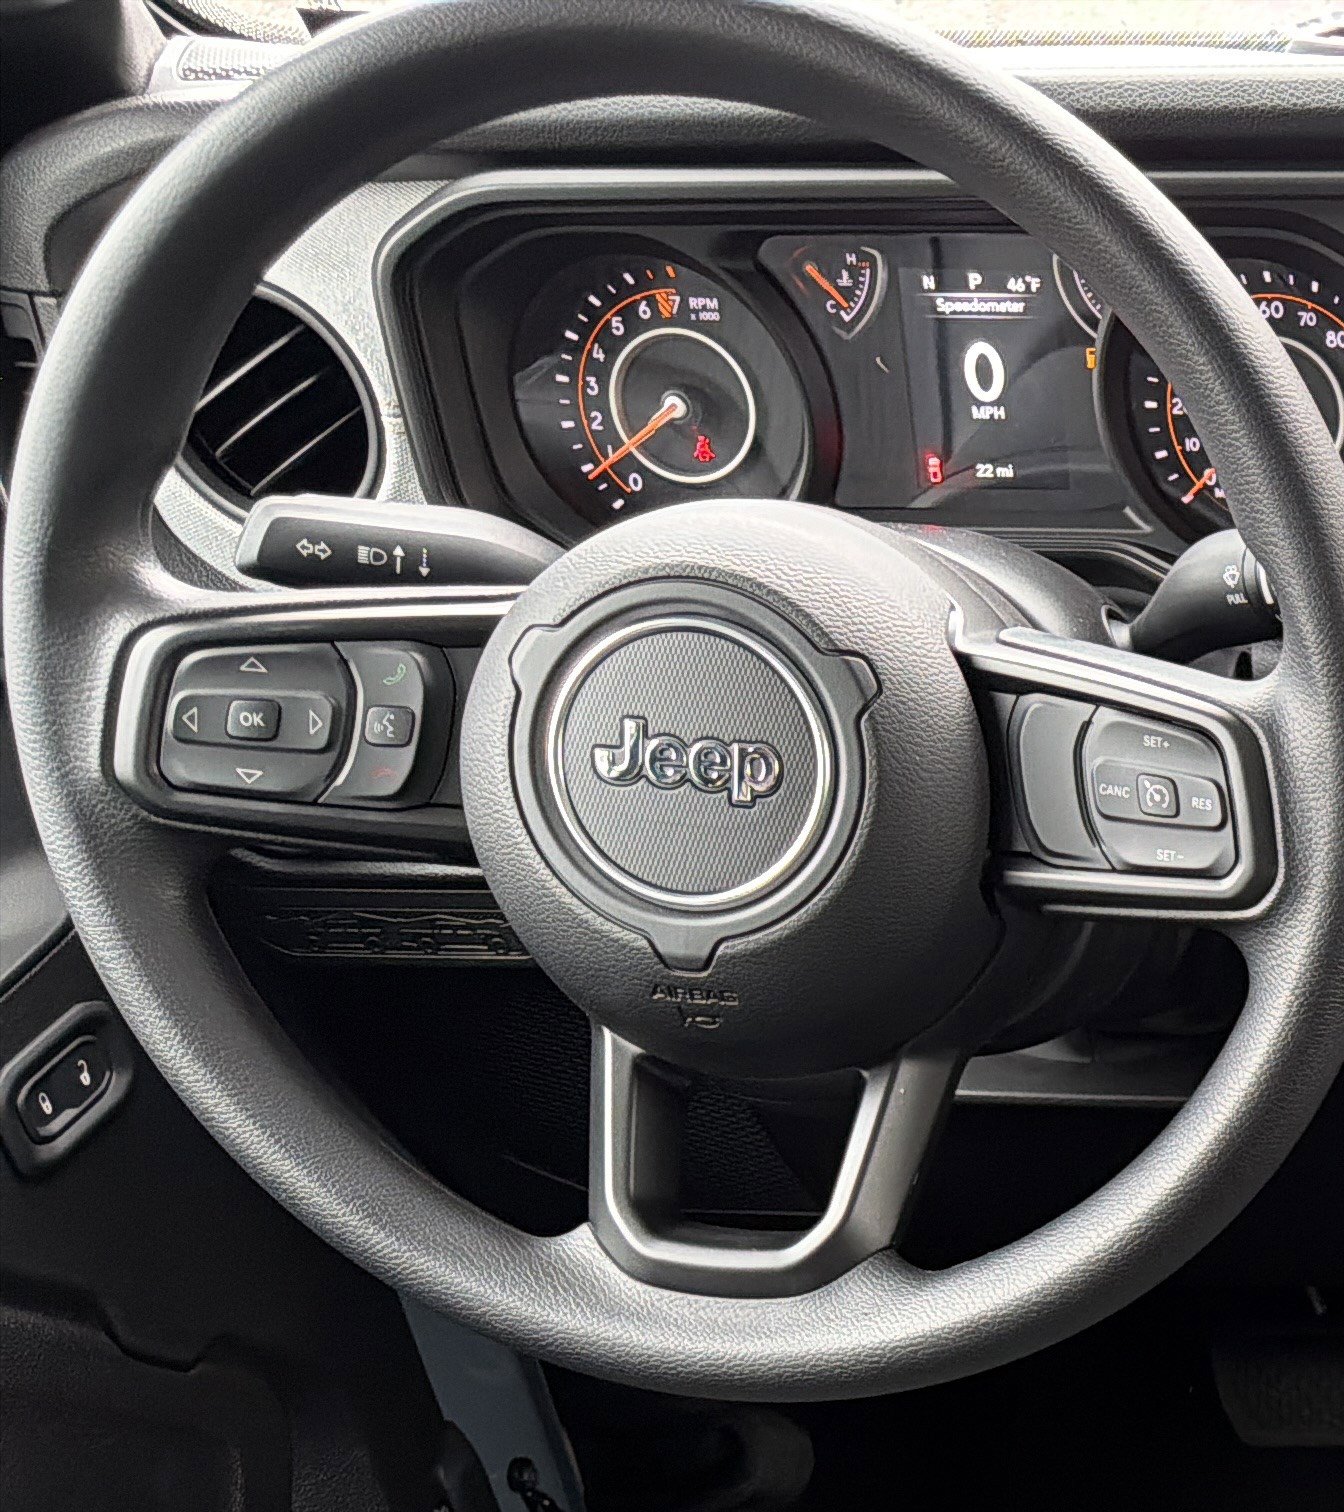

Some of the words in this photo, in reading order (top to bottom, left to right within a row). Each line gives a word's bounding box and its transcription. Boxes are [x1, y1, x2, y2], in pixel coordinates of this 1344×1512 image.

[846, 253, 856, 265] H
[922, 275, 935, 290] N
[968, 273, 983, 290] P
[638, 300, 651, 319] 6
[668, 295, 680, 314] 7
[689, 297, 719, 310] RPM
[826, 300, 837, 313] C
[935, 298, 1026, 314] Speedometer
[1259, 301, 1284, 319] 60
[611, 316, 625, 336] 5
[1297, 312, 1317, 327] 70
[593, 343, 605, 362] 4
[964, 341, 1005, 402] 0
[586, 376, 599, 396] 3
[590, 411, 603, 430] 2
[971, 405, 1006, 420] MPH
[1184, 437, 1200, 452] 10
[976, 463, 994, 478] 22
[996, 463, 1014, 478] mi
[629, 472, 643, 492] 0
[239, 711, 266, 727] OK
[1142, 735, 1171, 748] SET+
[591, 715, 784, 808] Jeep
[1099, 783, 1131, 799] CANC
[1191, 796, 1213, 811] RES
